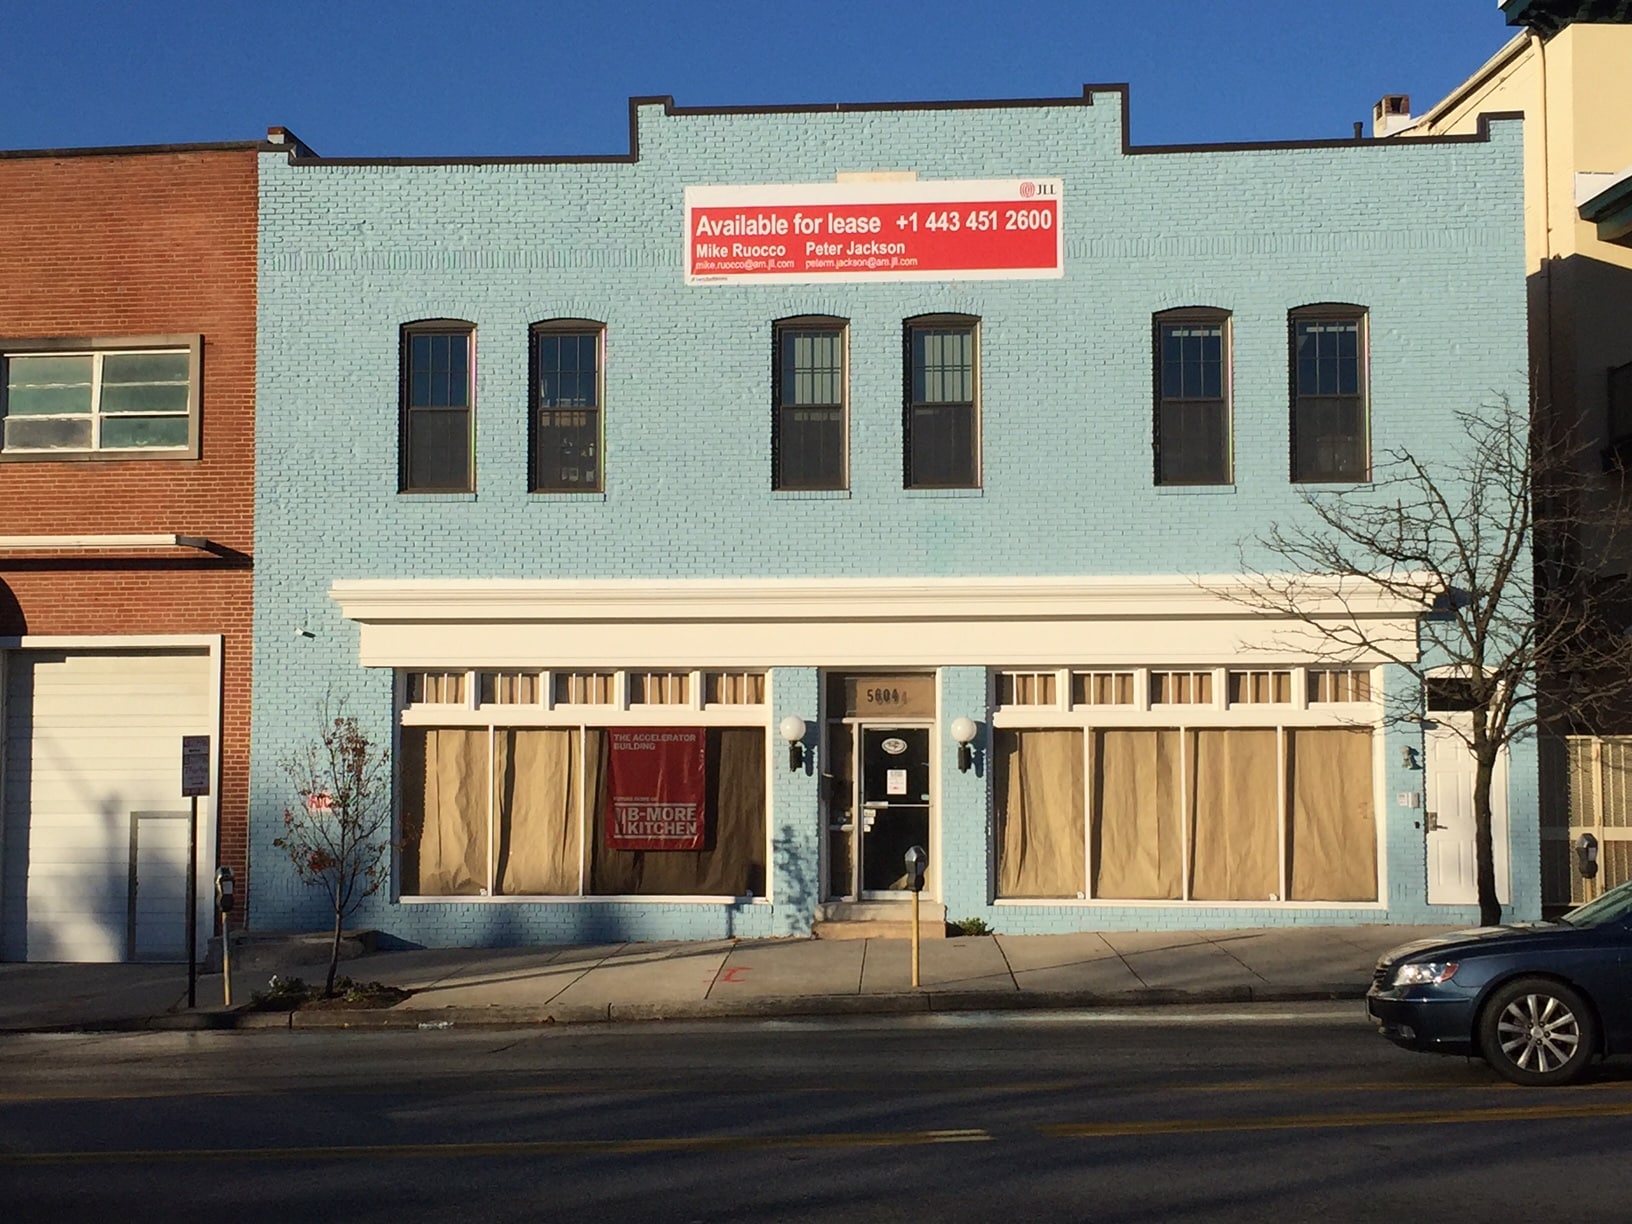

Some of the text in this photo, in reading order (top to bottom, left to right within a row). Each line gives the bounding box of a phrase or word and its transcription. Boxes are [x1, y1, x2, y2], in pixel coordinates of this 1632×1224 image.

[1036, 184, 1057, 196] JLL
[695, 209, 1052, 237] Available for lease +1 443 451 2600
[696, 242, 786, 258] Mike Ruocco
[805, 240, 906, 256] Peter Jackson
[695, 259, 795, 271] mike.ruocco@am.jll.com
[805, 257, 919, 270] peterm.jackson@am.jll.com
[613, 733, 697, 742] THE ACCELERATOR
[613, 742, 656, 751] BUILDING
[627, 807, 697, 821] B-MORE
[627, 821, 697, 835] KITCHEN
